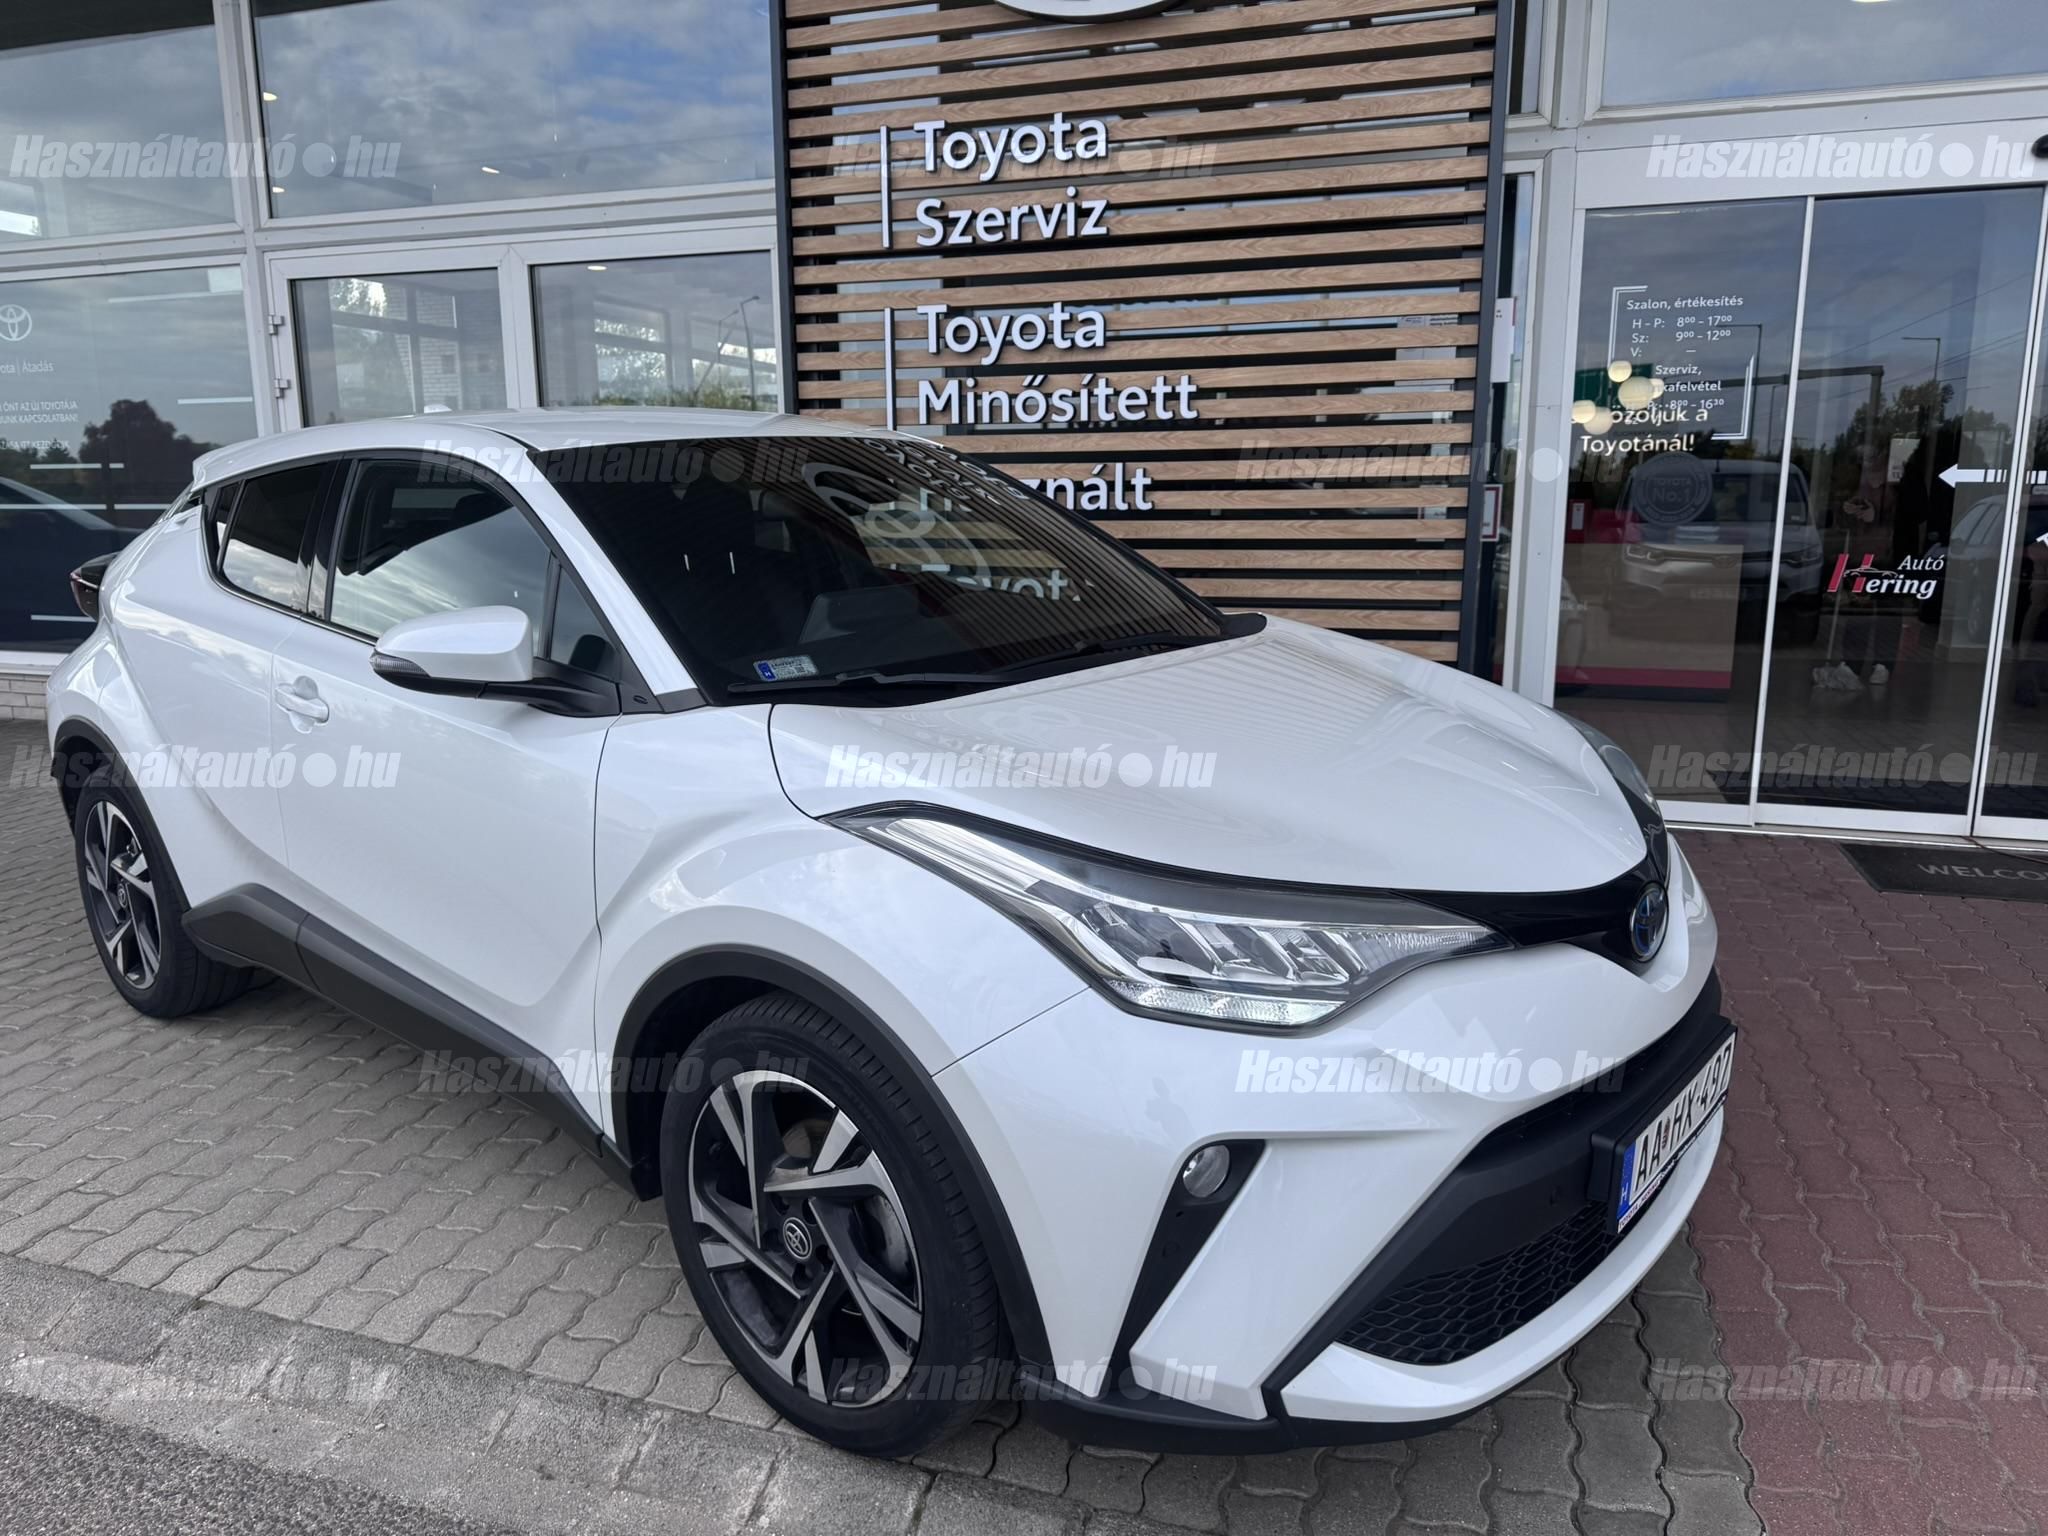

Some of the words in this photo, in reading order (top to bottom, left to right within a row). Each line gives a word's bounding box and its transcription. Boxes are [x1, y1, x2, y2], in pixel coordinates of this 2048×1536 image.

[913, 112, 1109, 182] Toyota
[916, 185, 1109, 246] Szerviz
[1626, 299, 1671, 310] Szalon,
[1674, 295, 1744, 309] értékesítés
[916, 301, 1106, 366] Toyota
[1655, 364, 1702, 376] Szerviz,
[918, 373, 1199, 424] Minősített
[1695, 408, 1709, 422] a
[1580, 433, 1695, 456] Toyotánál!
[1019, 462, 1154, 511] nált
[1897, 554, 1946, 571] Autó
